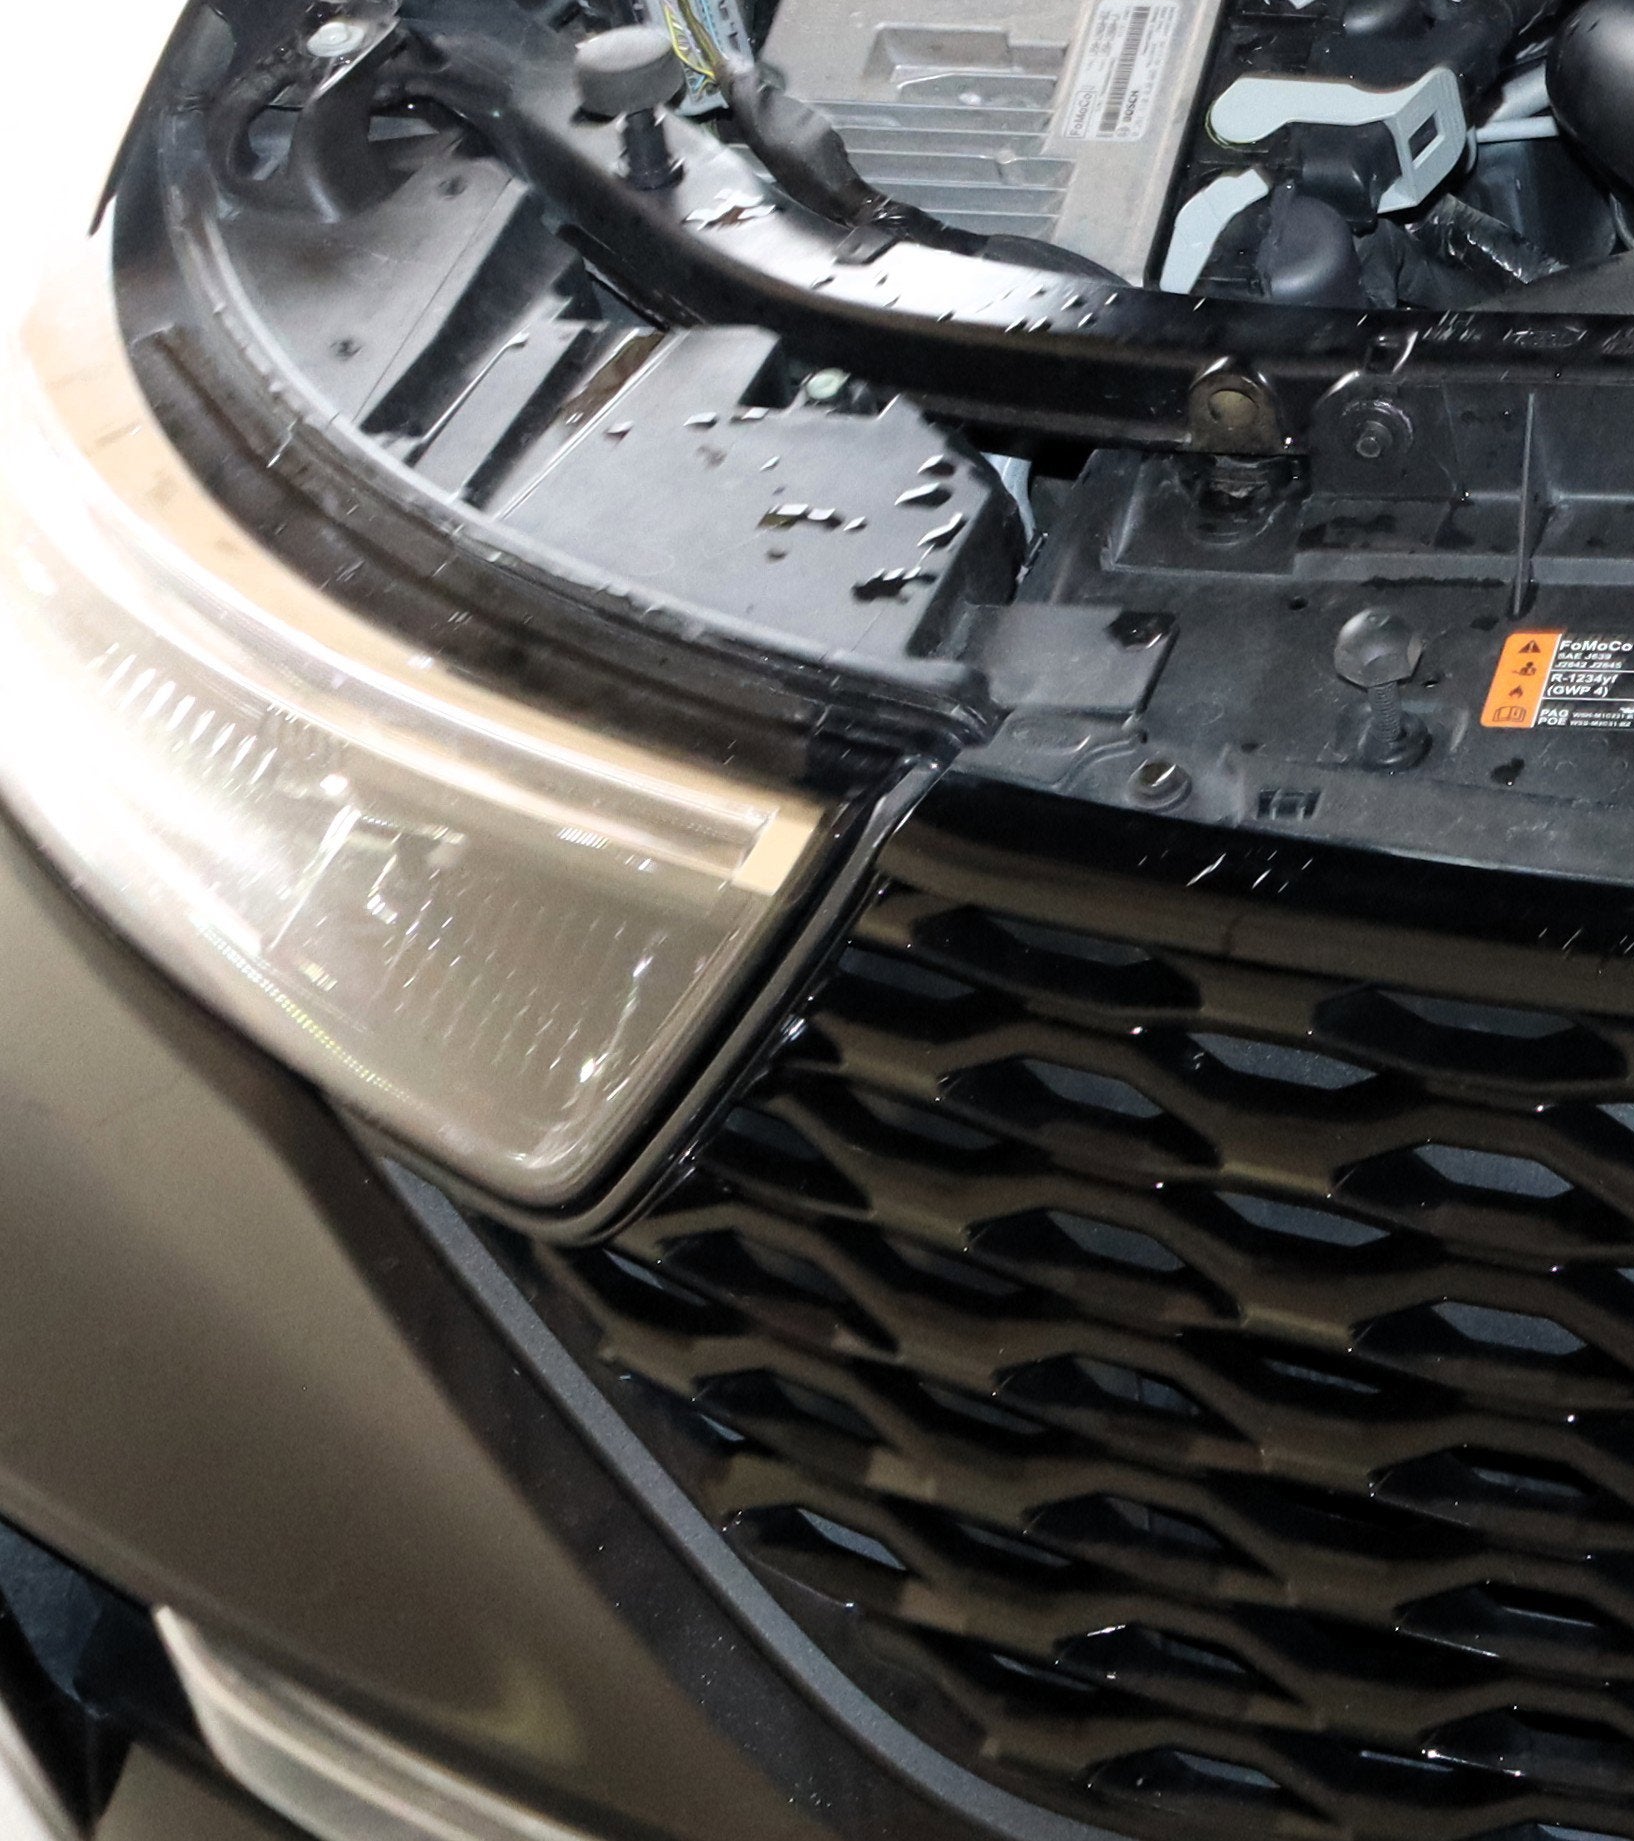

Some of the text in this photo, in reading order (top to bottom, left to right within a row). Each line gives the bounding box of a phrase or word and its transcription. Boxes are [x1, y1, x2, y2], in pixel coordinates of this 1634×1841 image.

[1122, 90, 1139, 123] BOSCH
[1069, 92, 1093, 136] FoMoCo
[1559, 640, 1633, 652] FoMoCo
[1550, 674, 1617, 686] R-1234yf
[1547, 686, 1609, 698] (GWP 4)
[1539, 709, 1569, 718] PAG
[1537, 717, 1567, 726] POE
